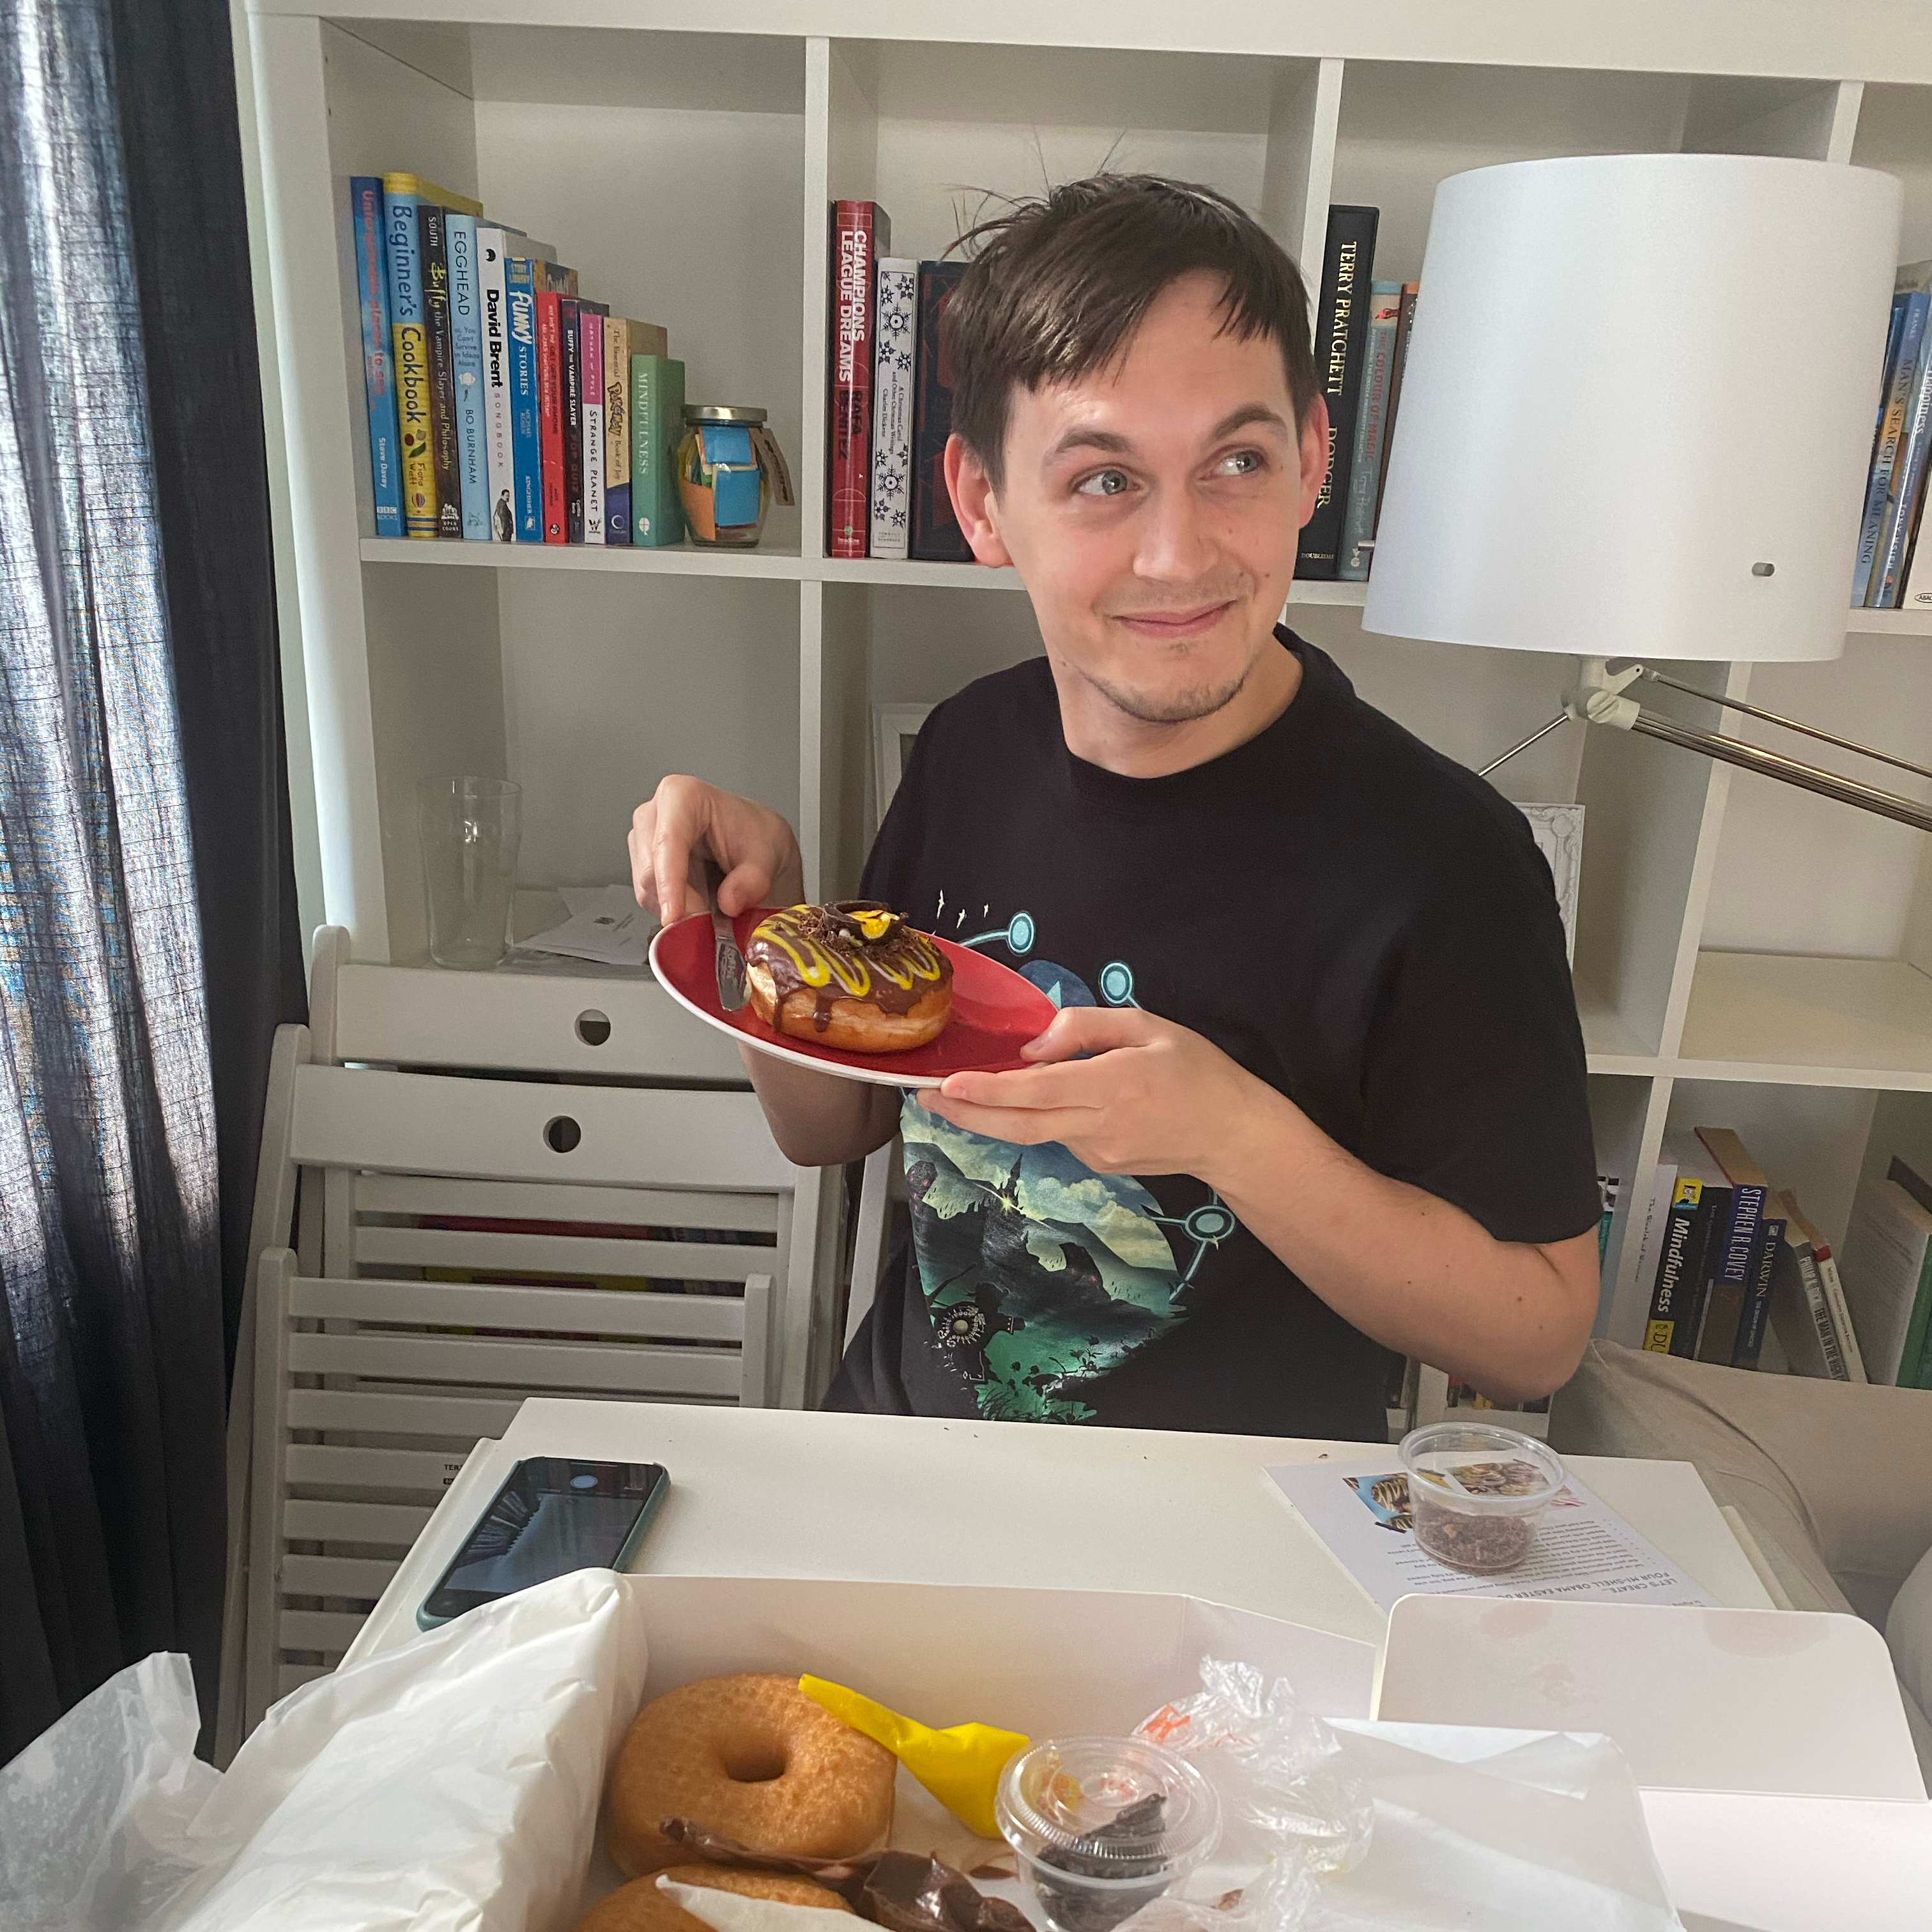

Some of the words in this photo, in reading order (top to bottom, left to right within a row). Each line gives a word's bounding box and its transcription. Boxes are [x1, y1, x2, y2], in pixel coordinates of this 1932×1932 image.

[427, 216, 438, 247] SOUTH
[390, 205, 417, 316] Beginner's
[454, 231, 470, 316] EGGHEAD
[840, 230, 854, 301] LEAGUE
[1337, 241, 1358, 295] TERRY
[424, 262, 447, 308] Buffy
[852, 230, 868, 342] CHAMPIONS
[368, 299, 383, 348] places
[434, 312, 444, 327] the
[487, 289, 501, 337] David
[509, 291, 533, 344] FUNNY
[374, 351, 385, 366] to
[435, 330, 445, 368] Vampire
[839, 305, 853, 382] DREAMS
[1326, 298, 1352, 396] PRATCHETT
[1379, 331, 1388, 350] THE
[375, 370, 386, 396] see
[402, 327, 427, 424] Cookbook
[489, 341, 503, 388] Brent
[518, 346, 529, 396] STORIES
[1372, 351, 1387, 401] COLOUR
[1895, 358, 1914, 405] MAN'S
[437, 371, 448, 401] Slayer
[440, 403, 448, 420] and
[465, 409, 474, 424] BO
[494, 392, 504, 468] SONGBOOK
[638, 372, 649, 475] MINDFULNESS
[838, 388, 850, 460] BENITEZ
[853, 388, 863, 435] RAFA
[1369, 404, 1379, 418] OF
[378, 438, 387, 461] Steve
[441, 422, 452, 471] Philosophy
[466, 428, 477, 484] BURNHAM
[589, 409, 597, 463] STRANGE
[1365, 423, 1377, 461] MAGIC
[1882, 409, 1903, 464] SEARCH
[379, 463, 388, 489] Davey
[417, 463, 425, 487] Fiona
[1353, 465, 1374, 494] Terry
[1876, 469, 1890, 495] FOR
[1861, 500, 1883, 564] MEANING
[1733, 1188, 1762, 1234] STEPHEN
[1731, 1236, 1752, 1245] R.
[1657, 1217, 1690, 1313] Mindfulness
[1724, 1246, 1749, 1281] COVEY
[1756, 1241, 1777, 1298] DARWIN
[1798, 1255, 1816, 1278] PHILIP
[1814, 1308, 1826, 1322] THE
[1818, 1321, 1832, 1338] MAN
[1822, 1337, 1834, 1347] IN
[1825, 1346, 1838, 1360] THE
[1514, 1586, 1554, 1598] EASTER
[1554, 1582, 1591, 1593] OBAMA
[1590, 1574, 1639, 1587] MI-SHELL
[1640, 1571, 1670, 1582] FOUR
[1648, 1577, 1677, 1587] LET'S
